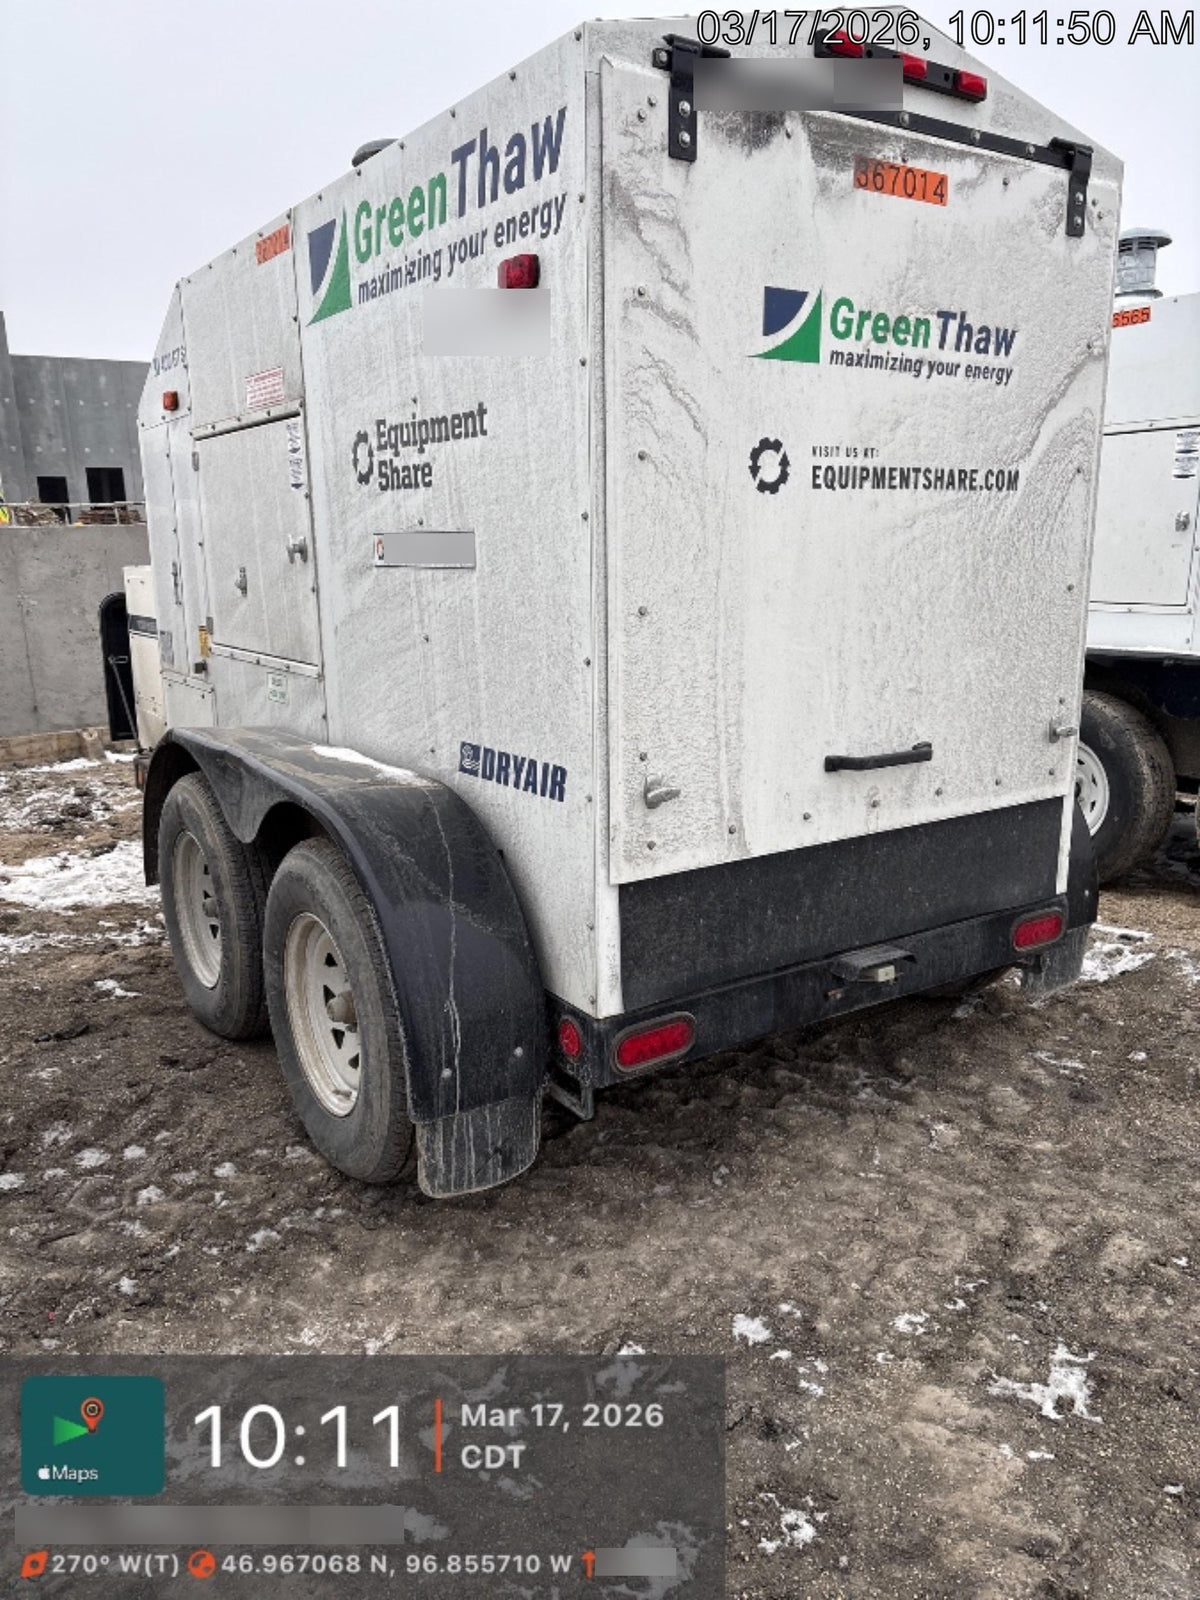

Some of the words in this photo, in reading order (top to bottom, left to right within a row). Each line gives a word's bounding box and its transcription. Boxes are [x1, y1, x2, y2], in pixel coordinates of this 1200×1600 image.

[358, 248, 443, 305] maximizing
[447, 226, 489, 278] your
[493, 191, 568, 248] energy
[829, 348, 924, 380] maximizing
[927, 358, 962, 380] your
[964, 362, 1014, 387] energy
[375, 401, 488, 458] Equipment
[811, 445, 841, 458] VISIT
[846, 445, 858, 458] US
[377, 458, 433, 492] Share
[811, 464, 1021, 492] EQUIPMENTSHARE.COM
[481, 745, 568, 803] DRYAIR
